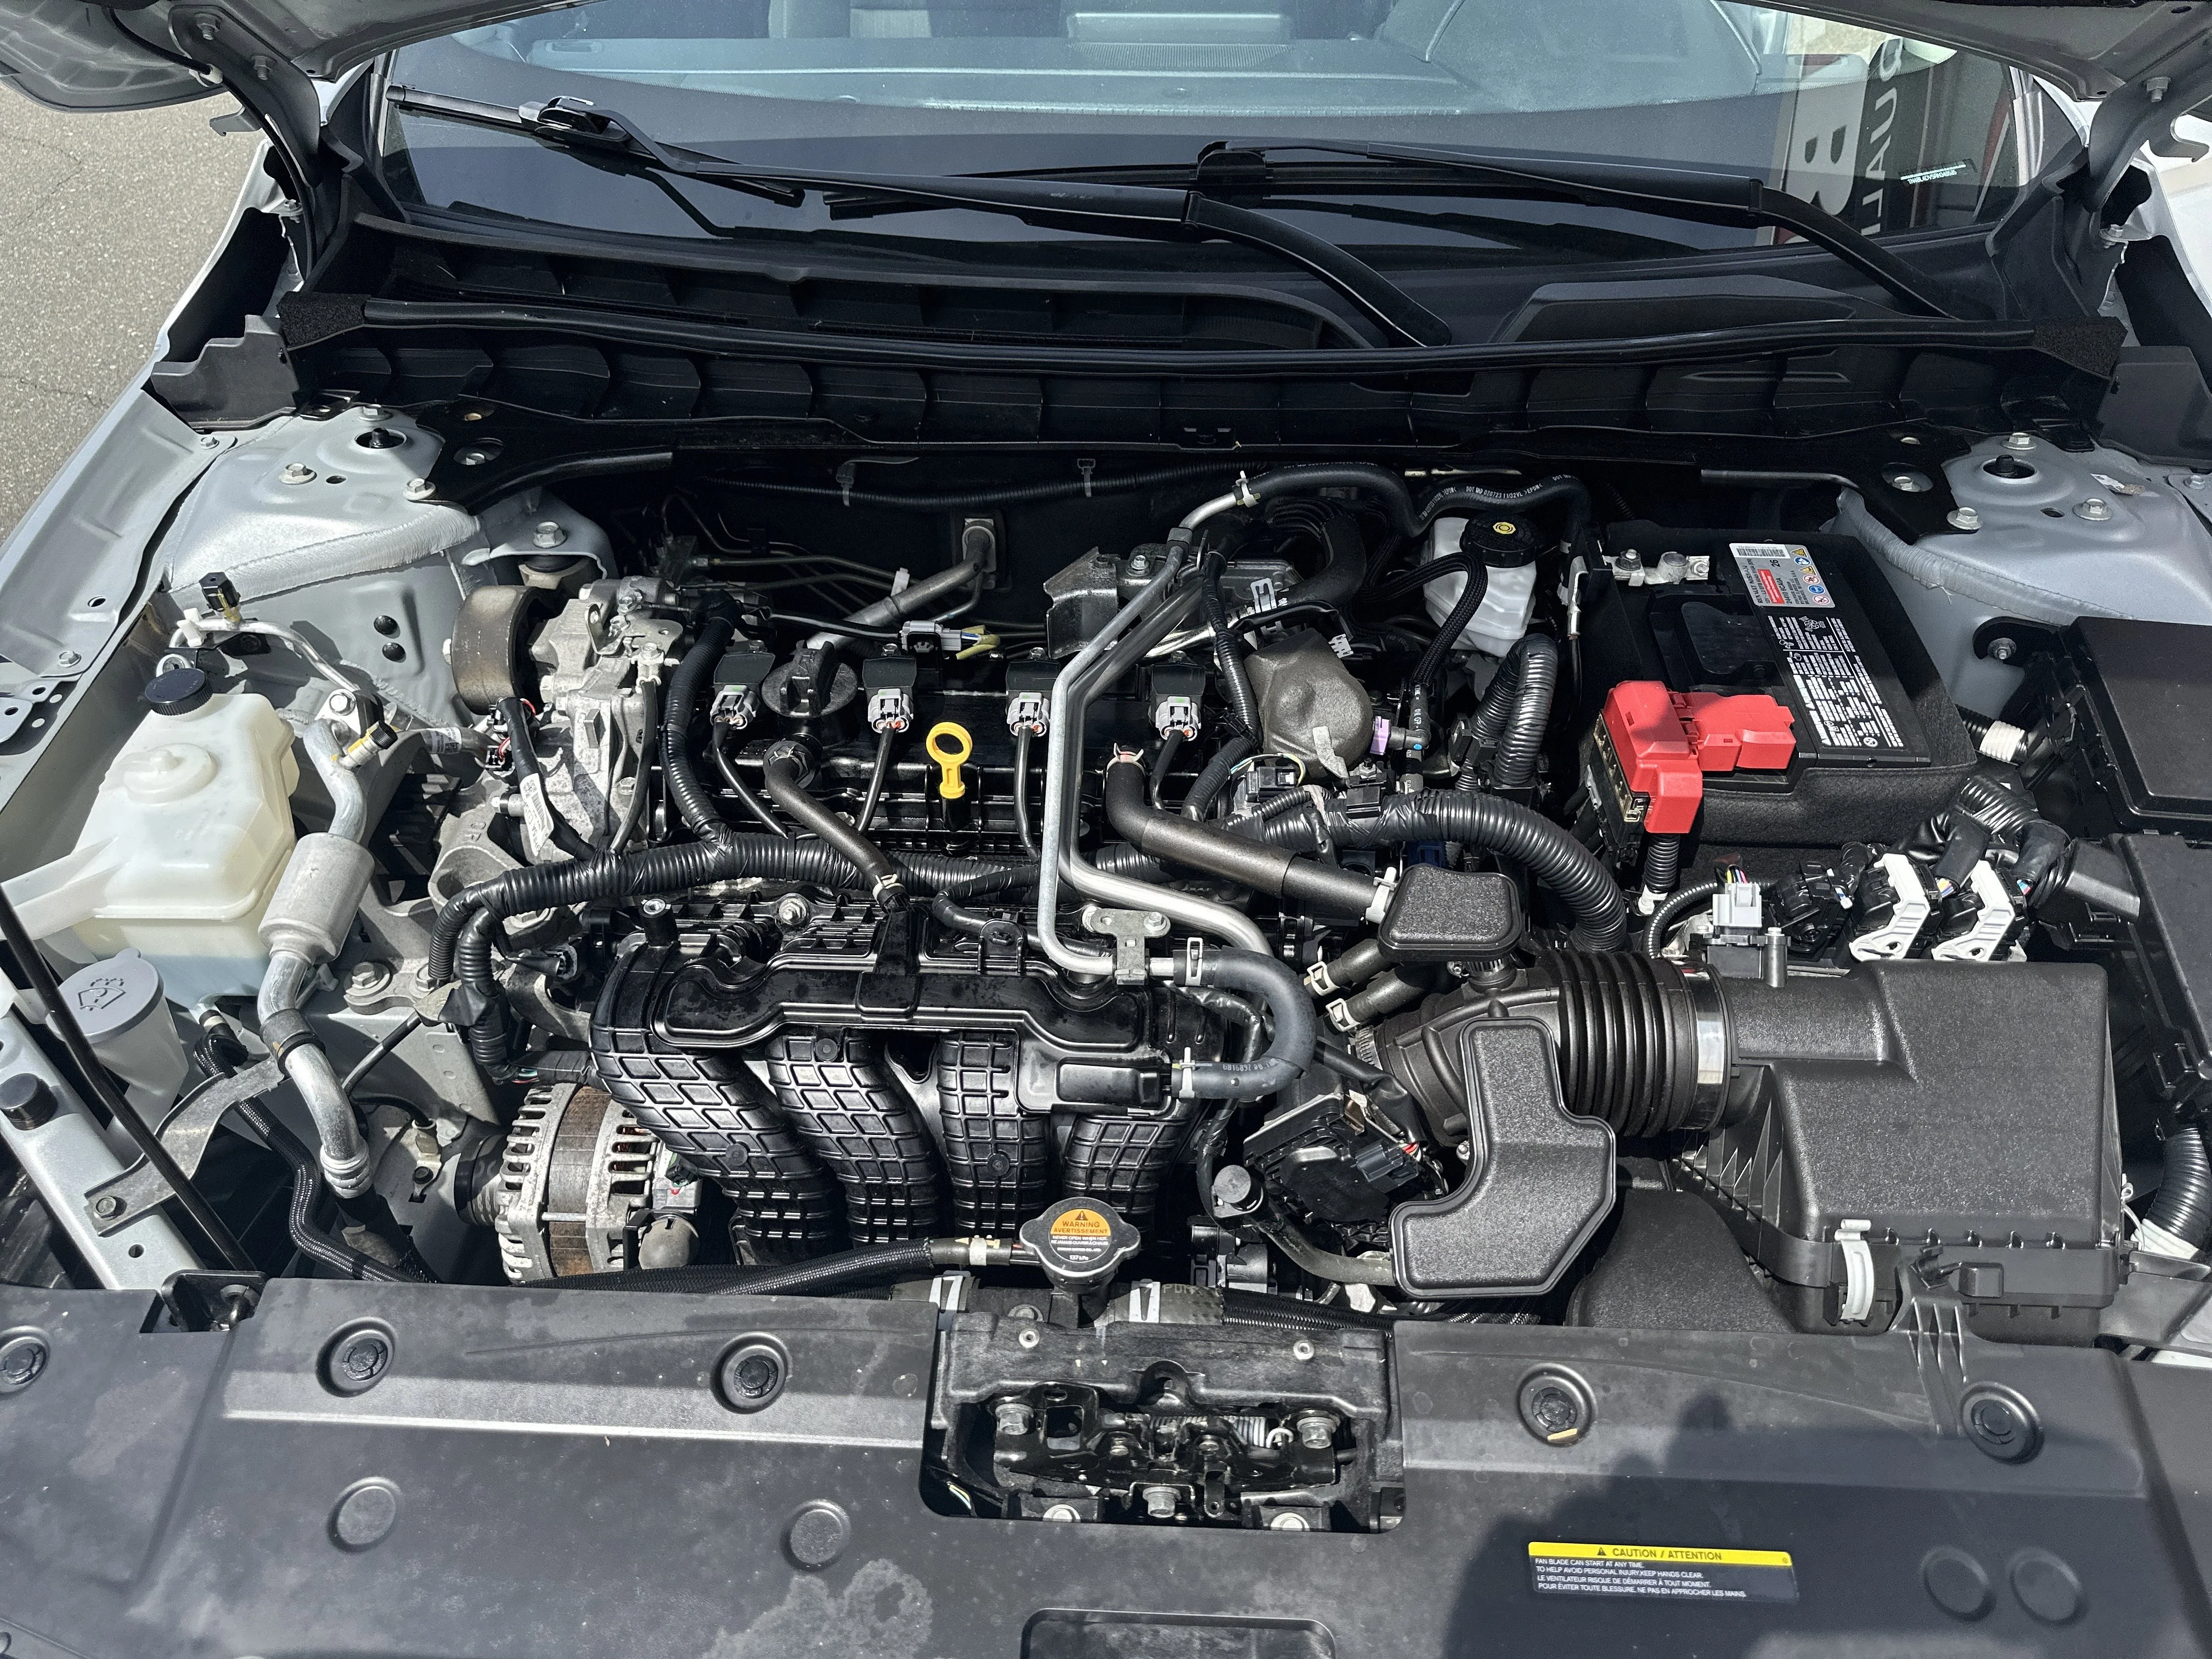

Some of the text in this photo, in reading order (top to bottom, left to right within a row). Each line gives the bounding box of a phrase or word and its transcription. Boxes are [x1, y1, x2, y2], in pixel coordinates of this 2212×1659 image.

[1741, 565, 1754, 584] NISSAN
[1612, 1548, 1657, 1558] CAUTION
[1668, 1551, 1722, 1560] ATTENTION
[1623, 1577, 1657, 1585] DÉMARRER
[1558, 1582, 1579, 1590] ÉVITER
[1671, 1588, 1711, 1596] APPROCHER
